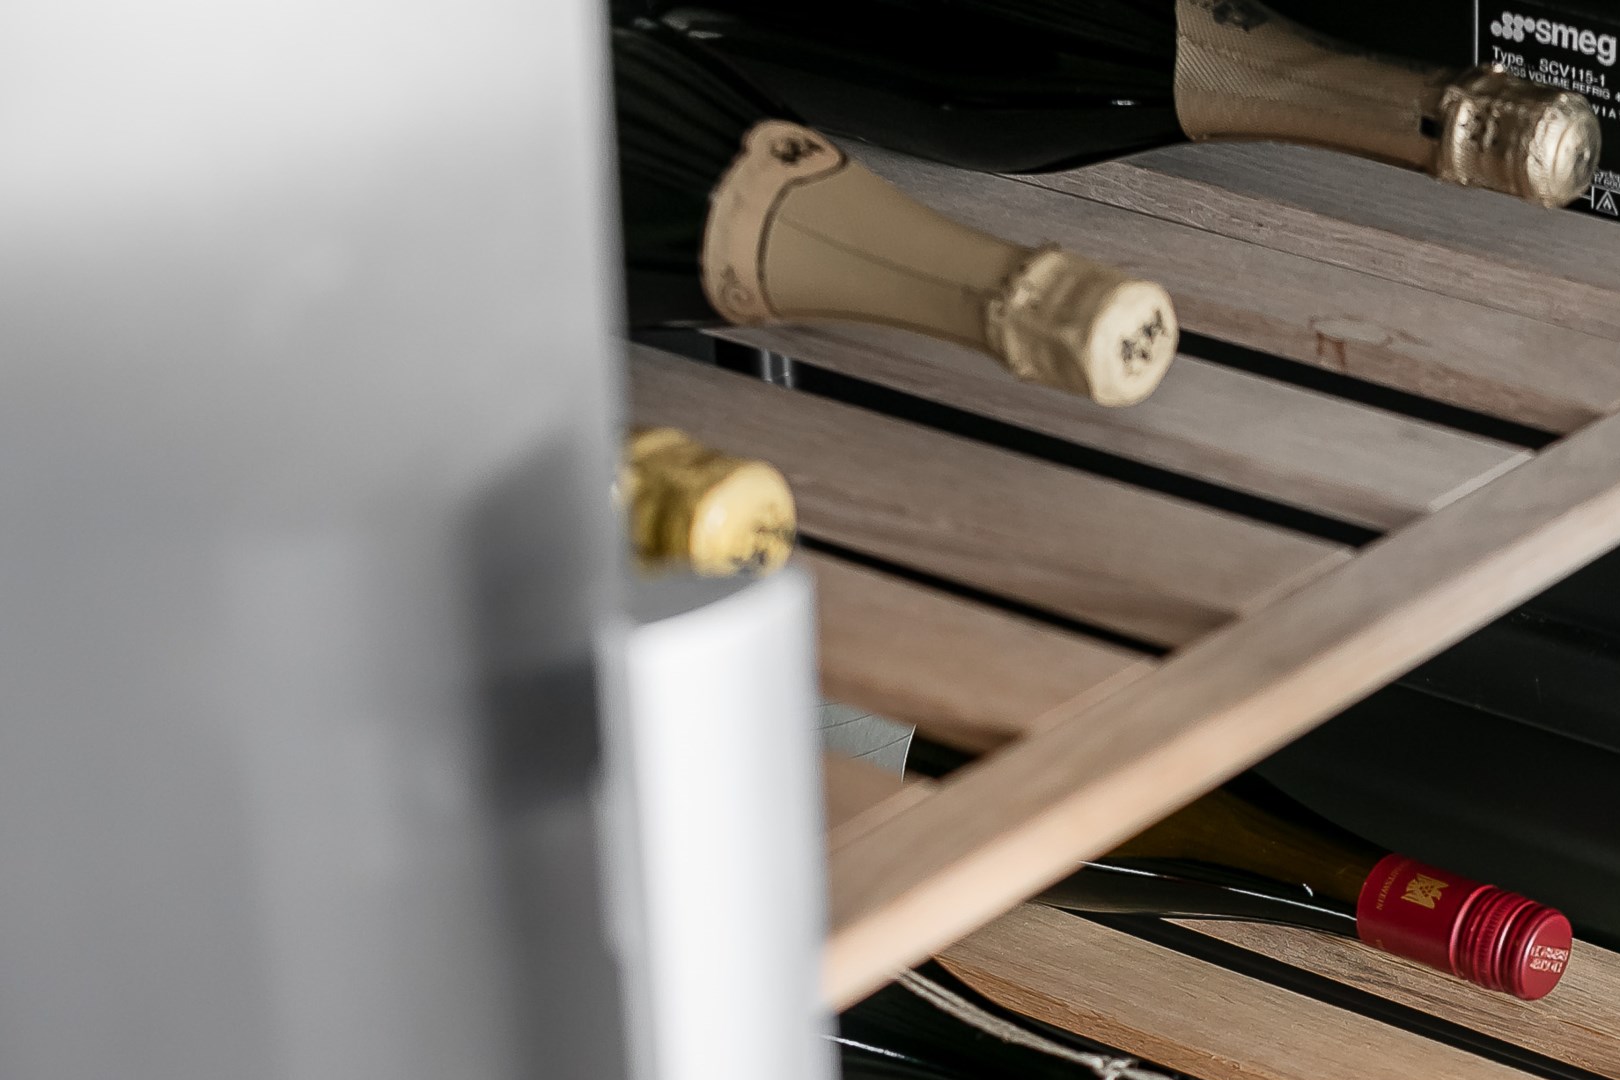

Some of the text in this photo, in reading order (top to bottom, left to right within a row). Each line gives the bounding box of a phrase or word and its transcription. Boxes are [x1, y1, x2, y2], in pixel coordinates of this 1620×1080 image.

[1535, 18, 1617, 67] smeg
[1492, 45, 1525, 68] Type
[1571, 80, 1611, 101] REFRIG
